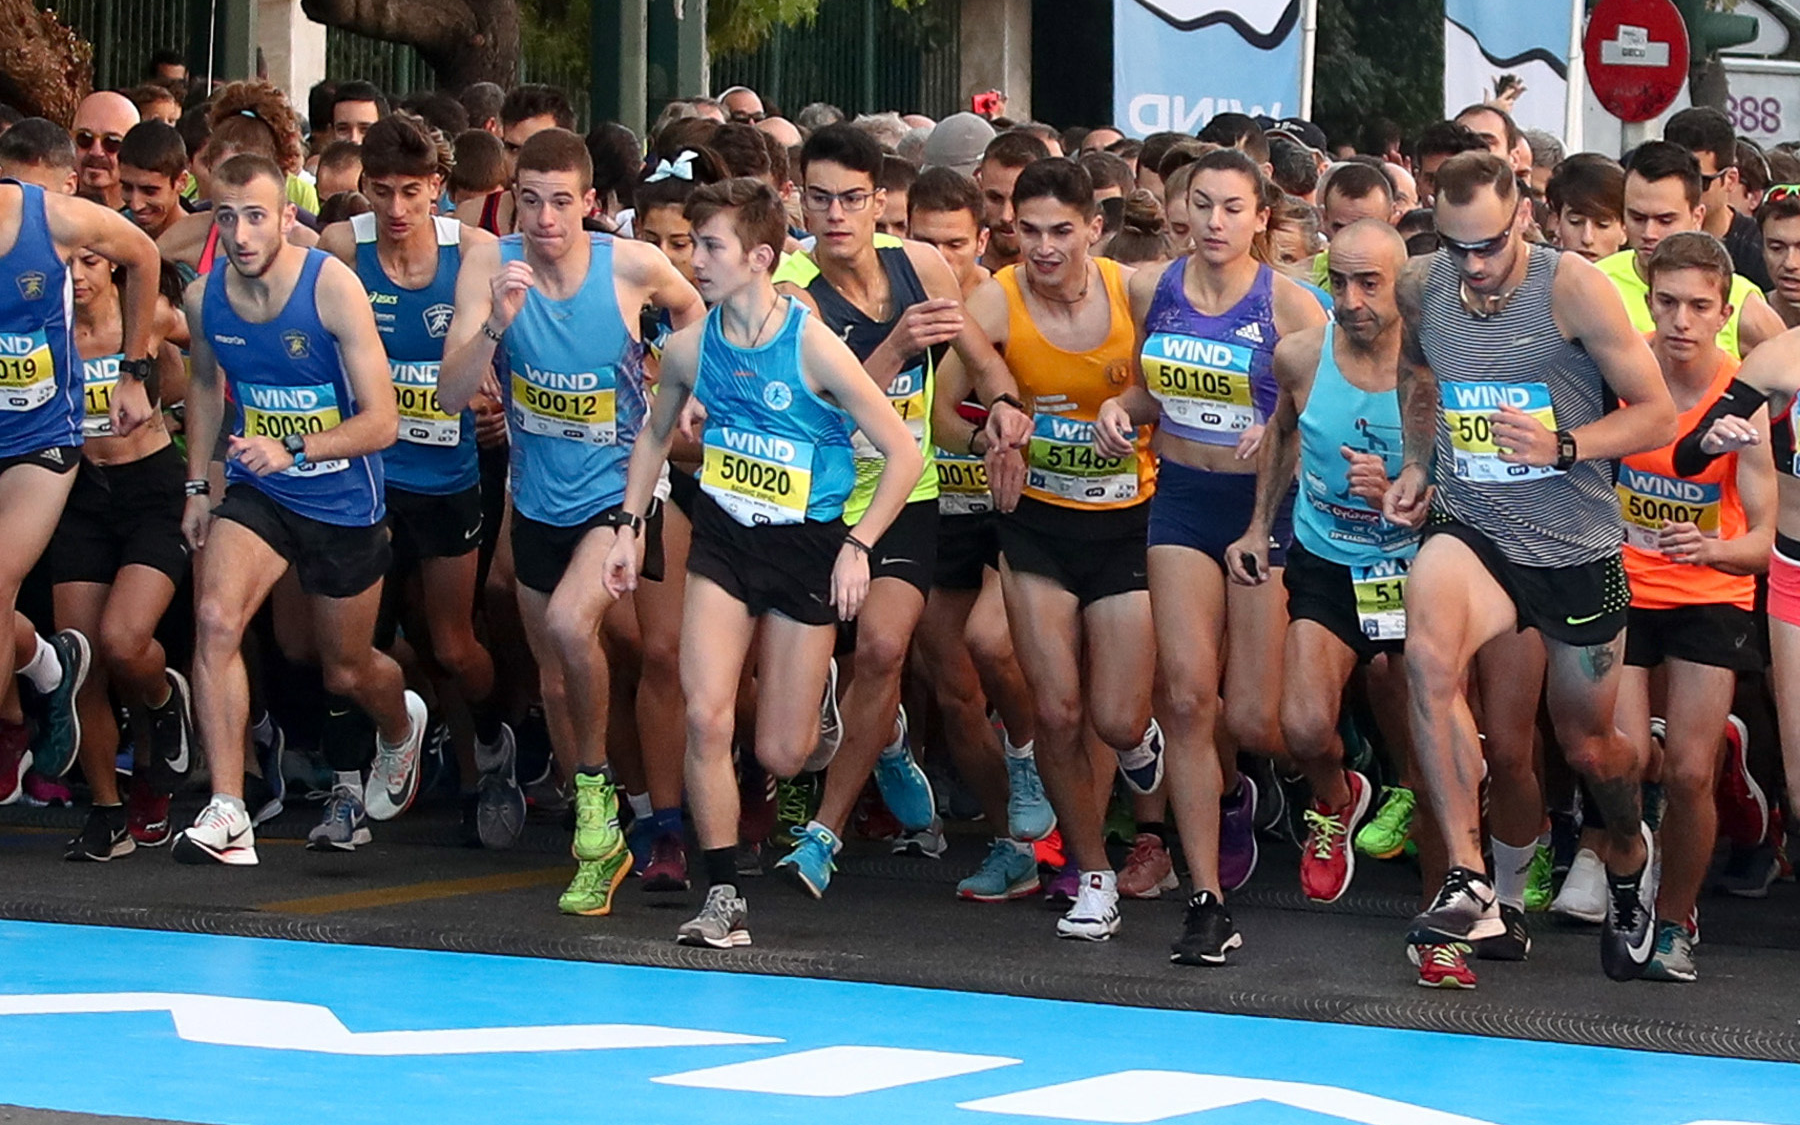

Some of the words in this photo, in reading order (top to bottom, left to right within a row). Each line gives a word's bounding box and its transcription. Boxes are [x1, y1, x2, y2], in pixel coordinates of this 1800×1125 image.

[1163, 336, 1233, 367] WIND
[525, 363, 598, 391] WIND
[1160, 365, 1232, 396] 50105
[251, 387, 319, 409] WIND
[525, 385, 597, 416] 50012
[1454, 385, 1531, 408] WIND
[256, 414, 324, 438] 50030
[722, 427, 796, 463] WIND
[720, 455, 792, 496] 50020
[937, 461, 989, 486] 0013
[1628, 470, 1705, 502] WIND
[1629, 495, 1704, 525] 50007
